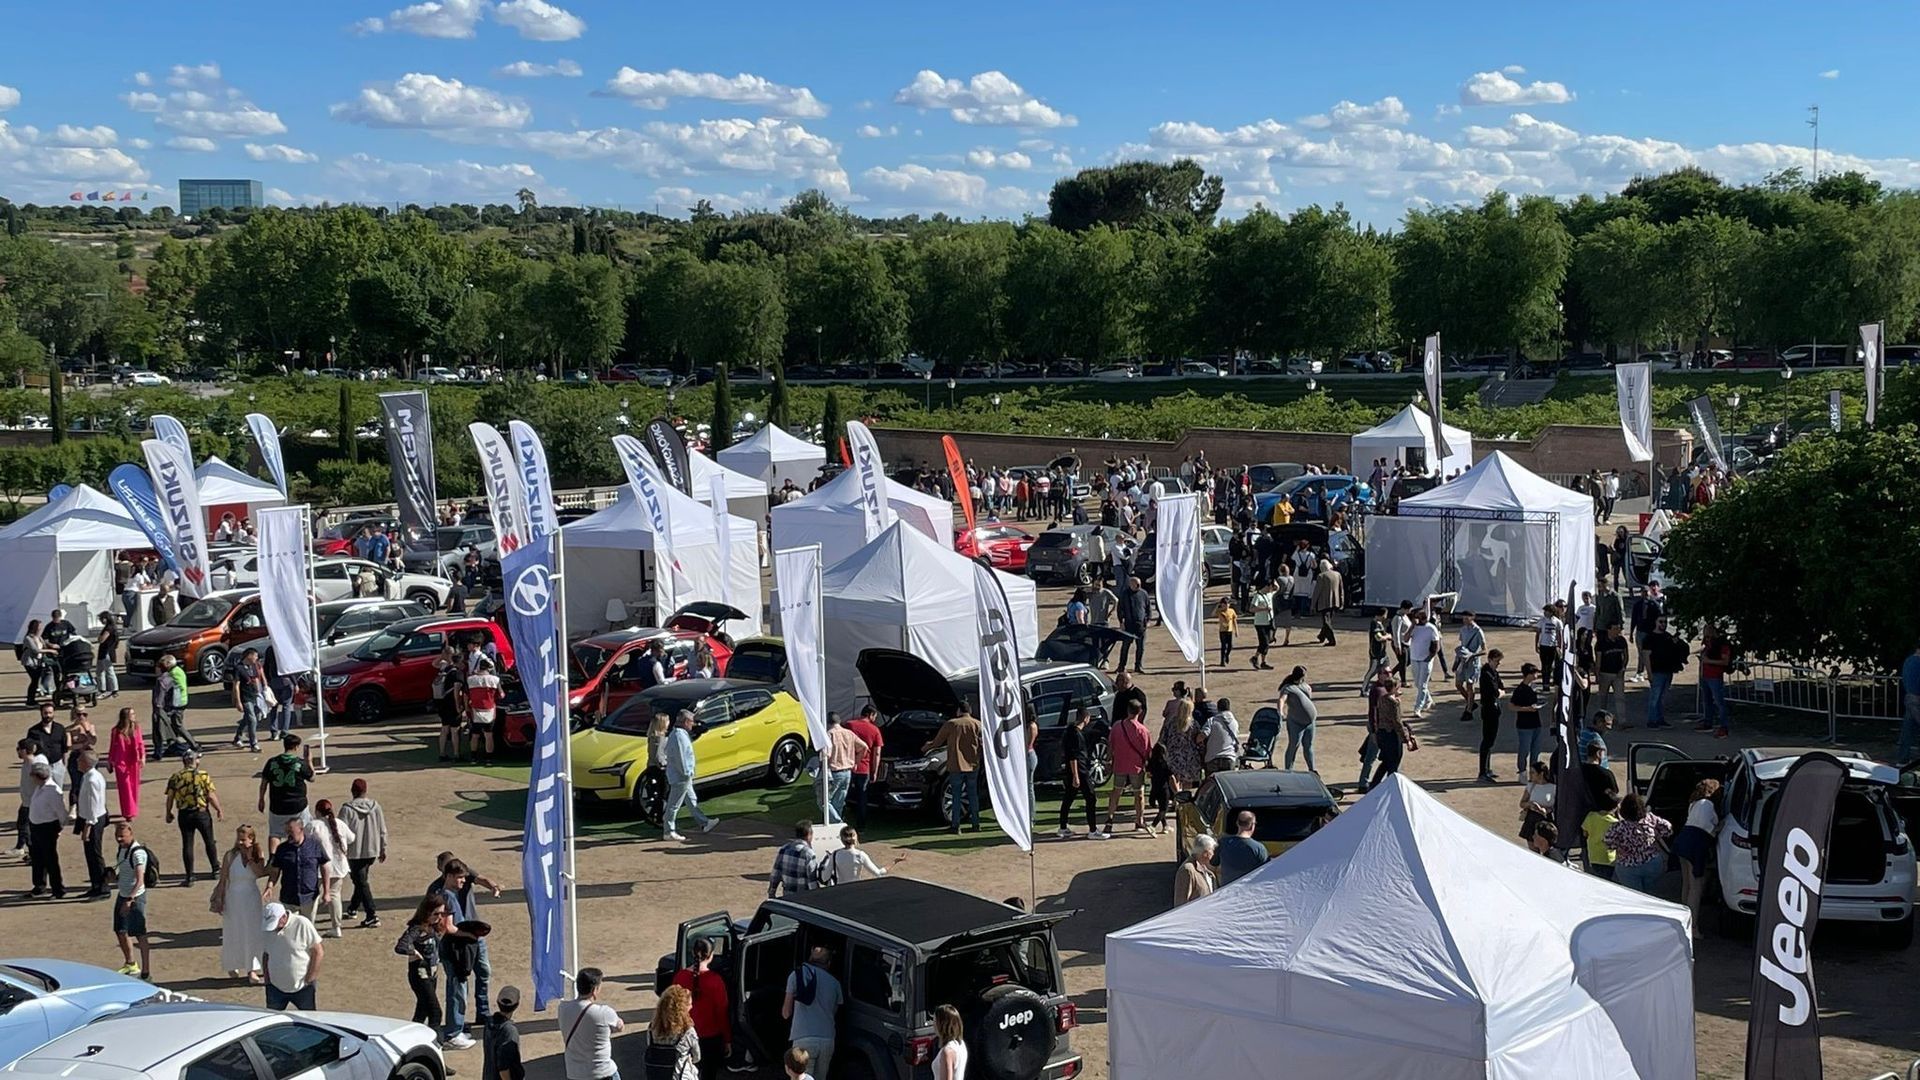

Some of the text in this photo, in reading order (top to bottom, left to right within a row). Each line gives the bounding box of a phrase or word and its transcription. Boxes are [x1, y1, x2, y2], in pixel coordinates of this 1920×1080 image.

[272, 768, 296, 788] 34
[1760, 827, 1822, 1026] Jeep
[999, 1009, 1034, 1030] Jeep
